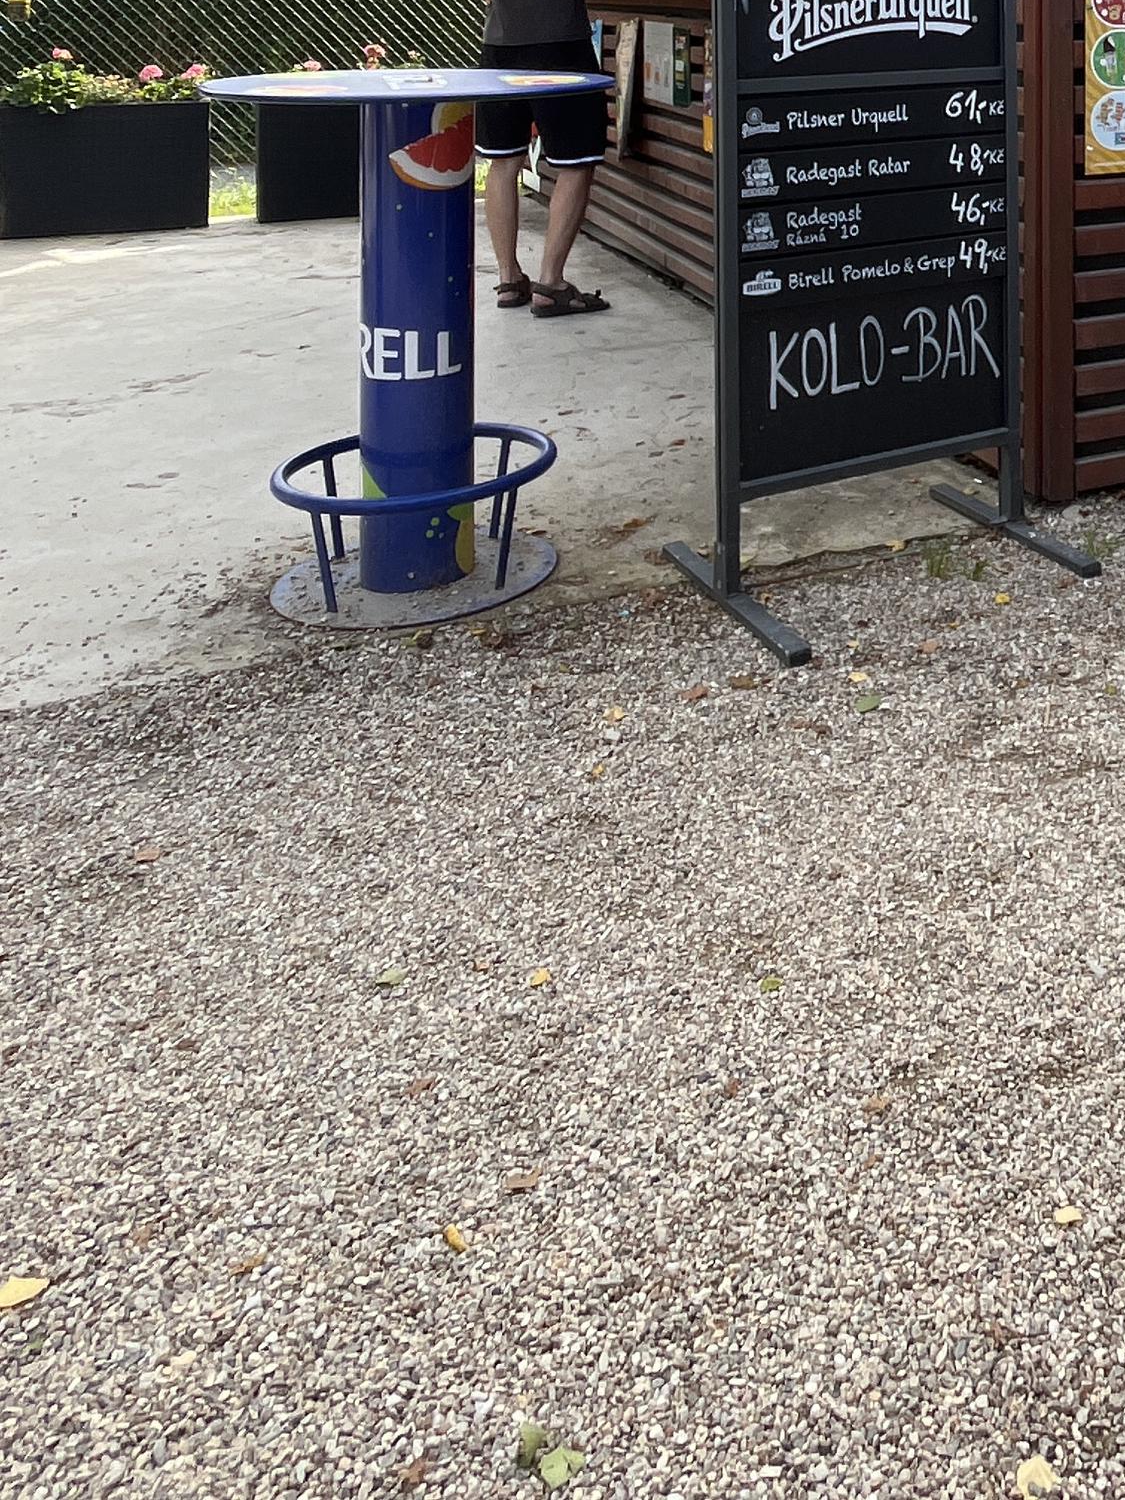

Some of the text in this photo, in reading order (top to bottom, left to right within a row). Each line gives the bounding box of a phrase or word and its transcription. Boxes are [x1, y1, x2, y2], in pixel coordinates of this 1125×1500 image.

[787, 110, 845, 131] Pilsner
[851, 104, 909, 132] Urquell
[786, 157, 862, 186] Radegast
[868, 158, 911, 176] Ratar
[787, 203, 862, 230] Radegast
[786, 230, 826, 247] Rázná
[839, 224, 860, 240] 10
[788, 267, 834, 290] Birell
[842, 261, 901, 283] Pomelo
[903, 258, 914, 273] &
[917, 254, 955, 278] Grep
[769, 294, 1000, 411] KOLO-BAR
